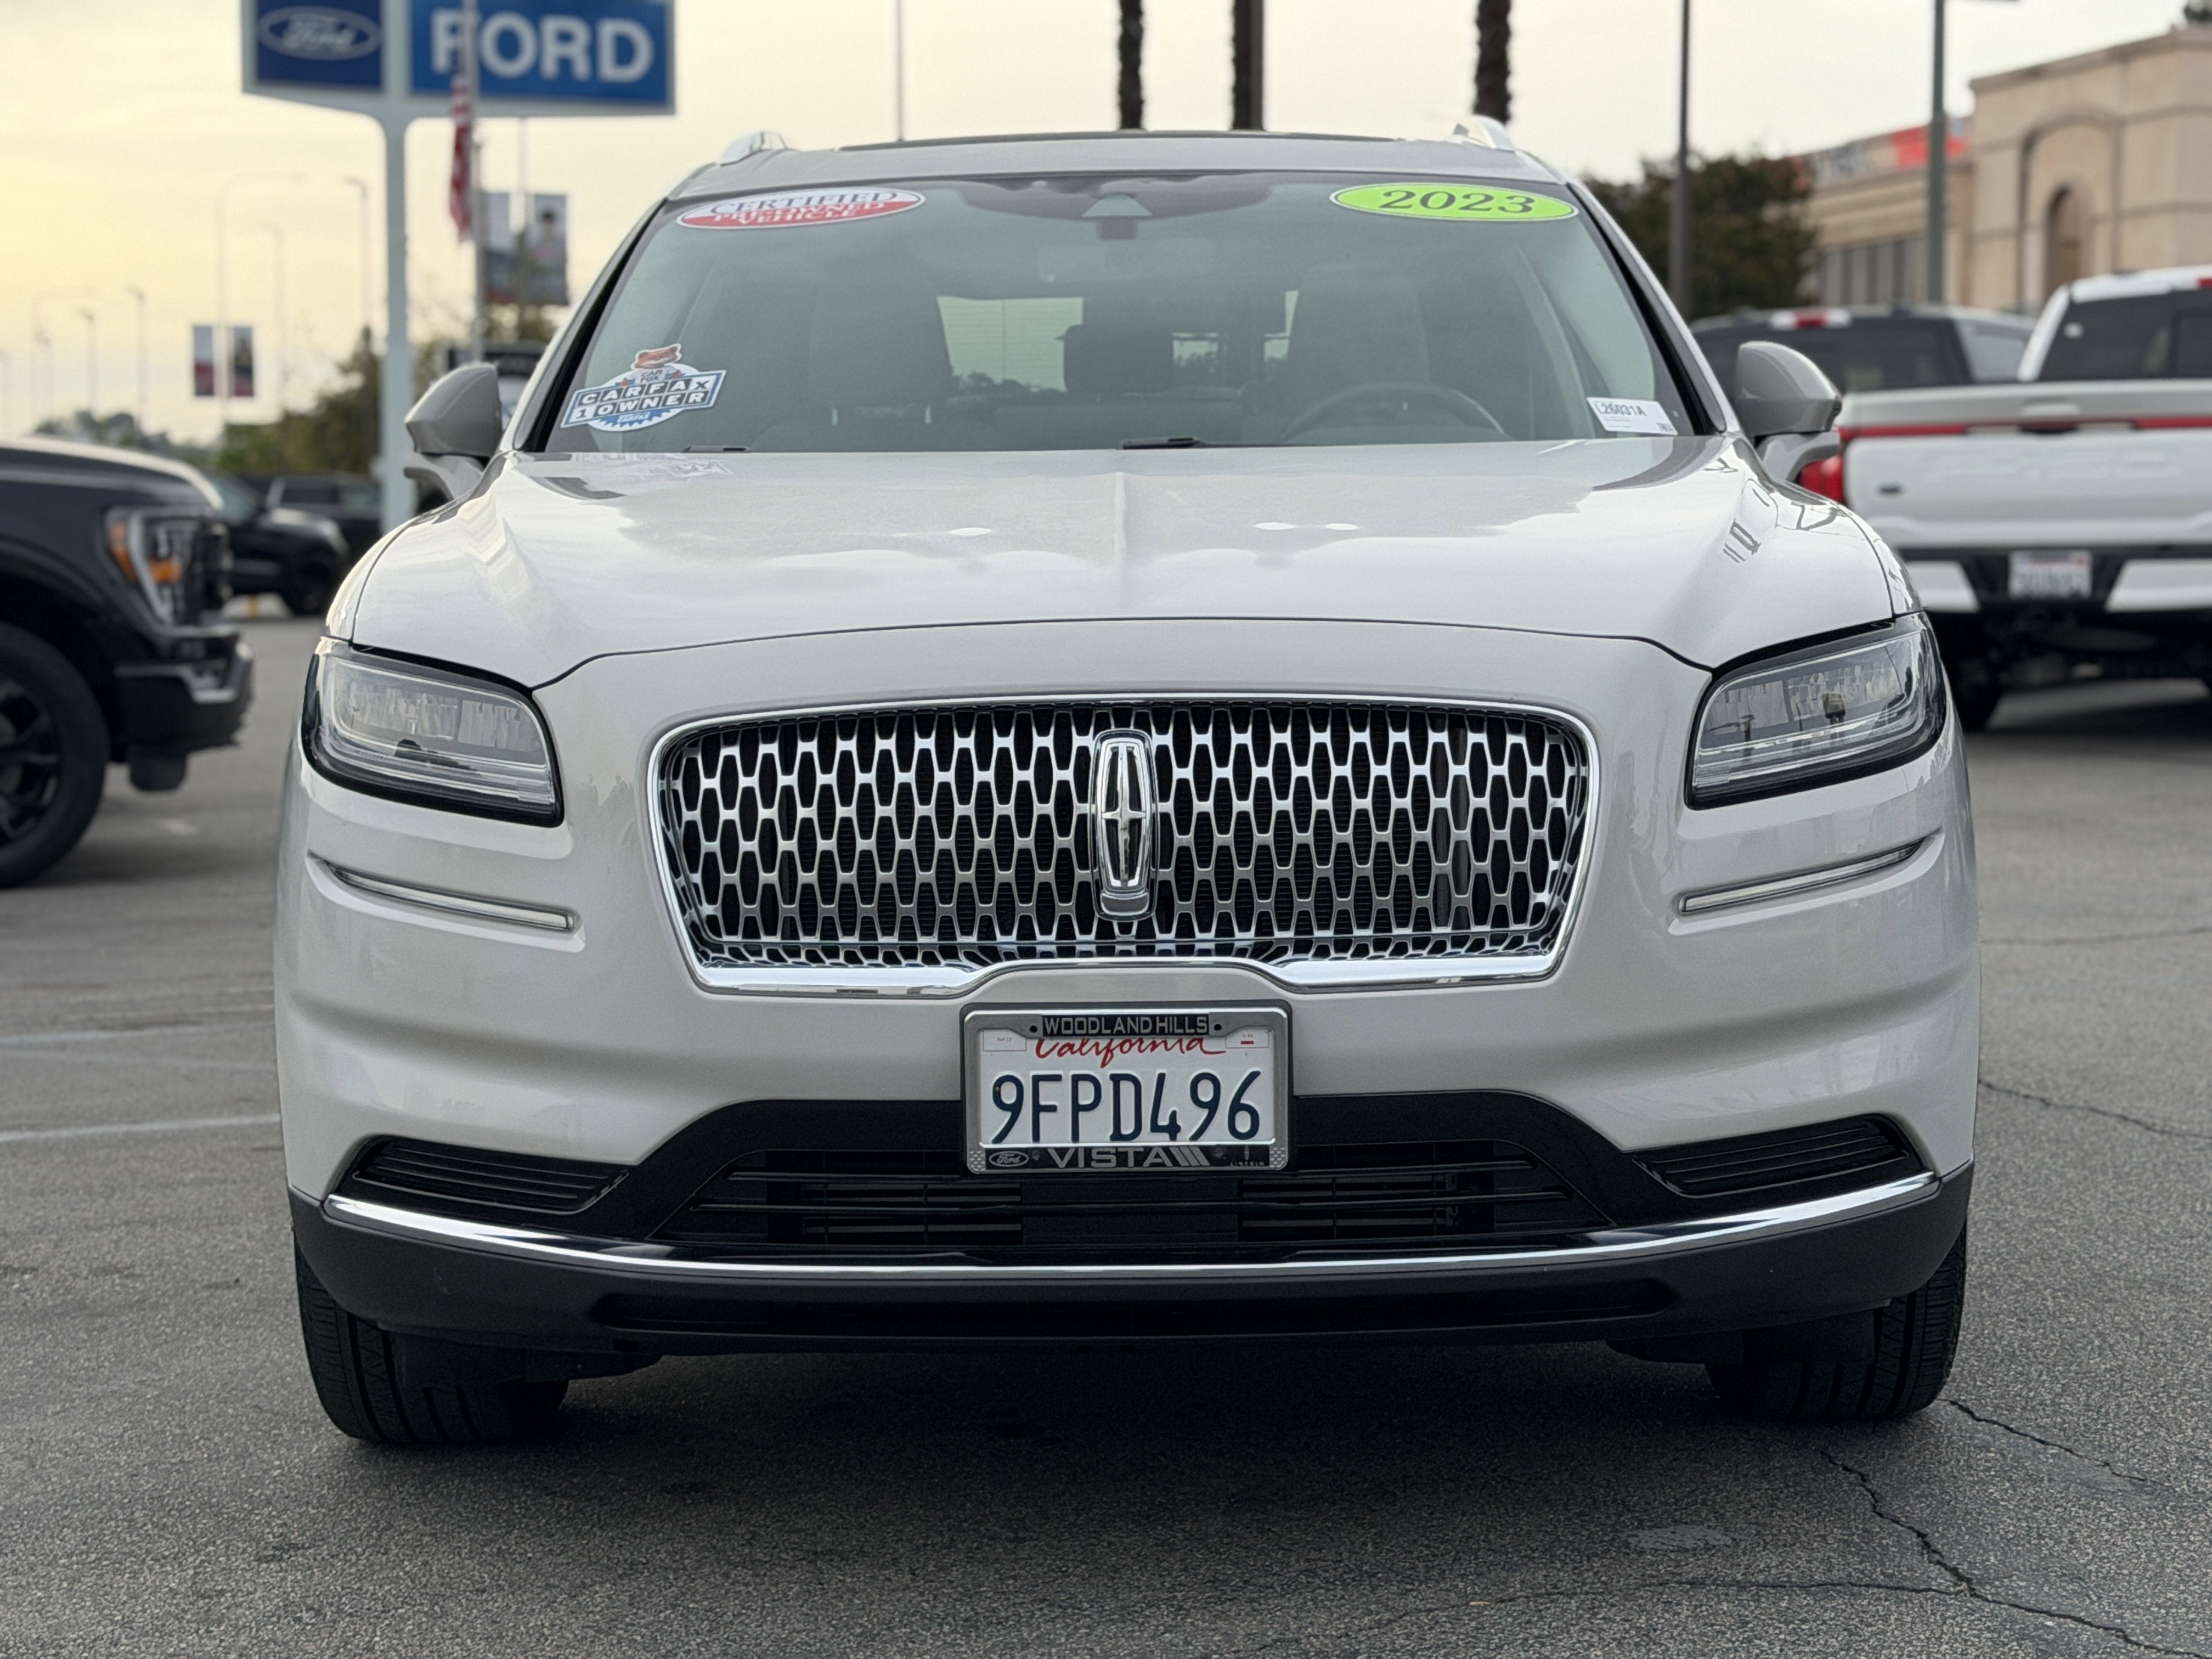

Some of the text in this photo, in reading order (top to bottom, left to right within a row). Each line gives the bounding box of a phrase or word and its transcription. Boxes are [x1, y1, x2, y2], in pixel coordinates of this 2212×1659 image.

[431, 10, 654, 83] FORD
[710, 192, 898, 214] CERTIFIED
[1378, 190, 1536, 213] 2023
[580, 380, 710, 404] CARFAX
[576, 392, 705, 418] 1 OWNER
[1044, 1016, 1207, 1035] WOODLAND HILLS
[1035, 1037, 1226, 1069] California
[991, 1071, 1261, 1143] 9FPD496
[996, 1153, 1022, 1163] Ford
[1047, 1147, 1173, 1168] VISTA
